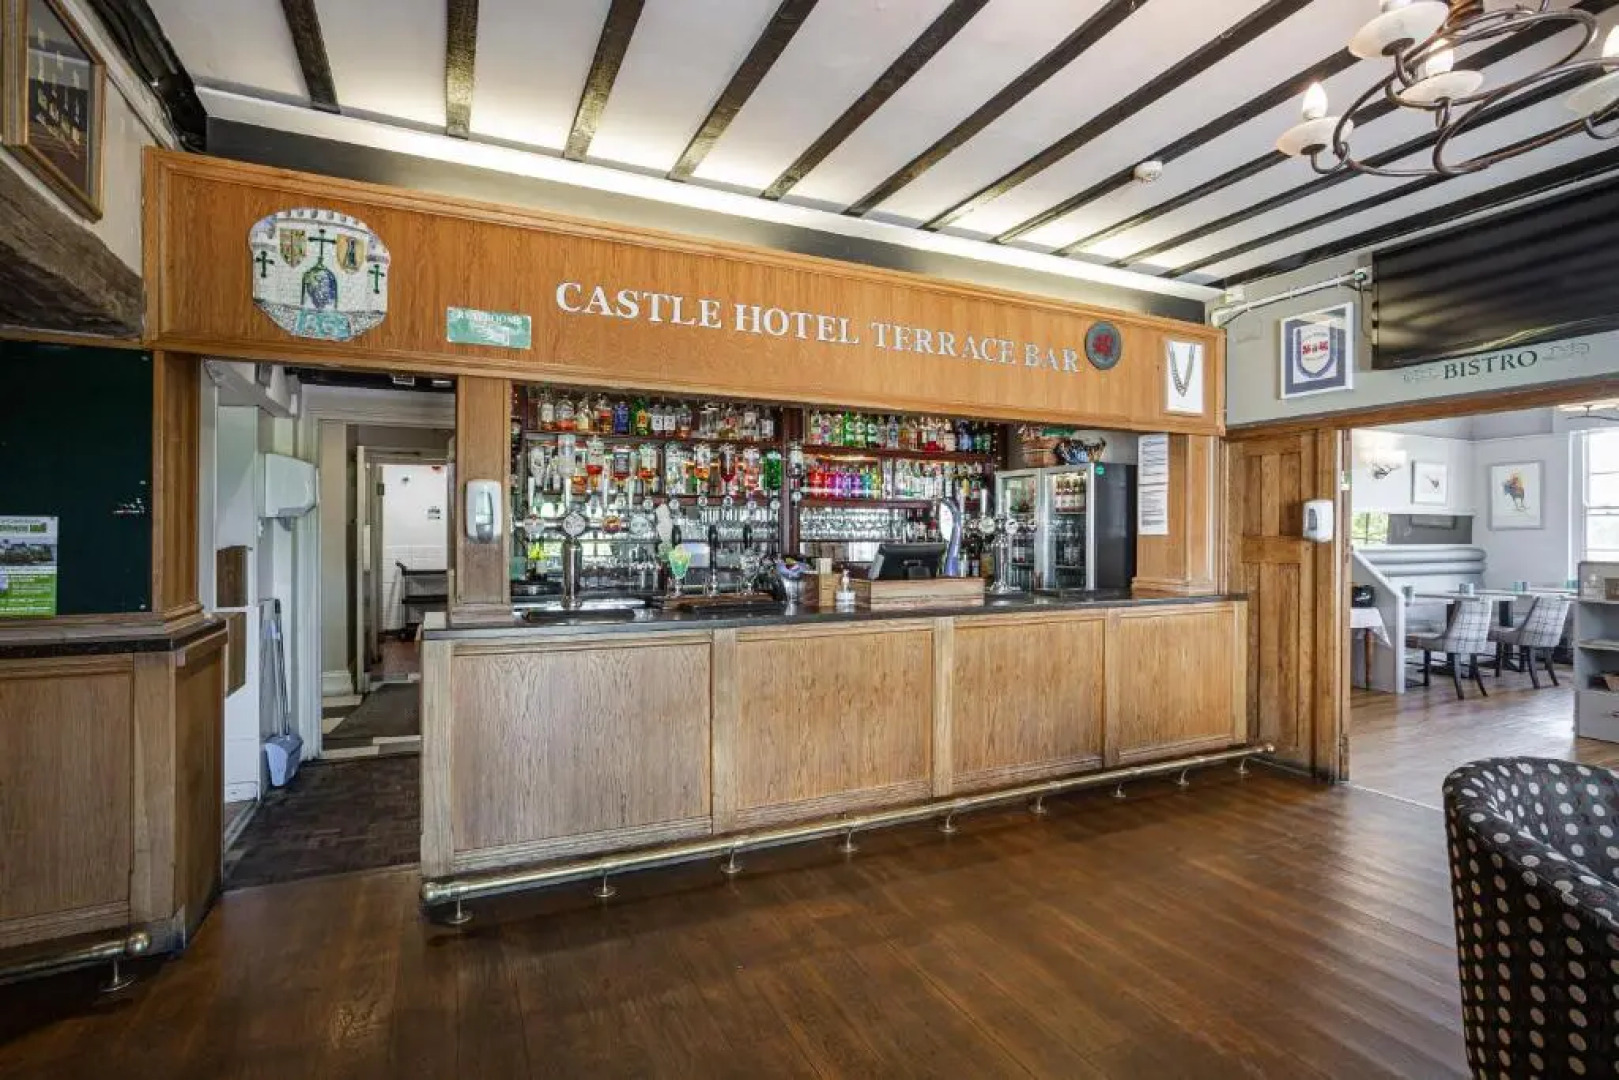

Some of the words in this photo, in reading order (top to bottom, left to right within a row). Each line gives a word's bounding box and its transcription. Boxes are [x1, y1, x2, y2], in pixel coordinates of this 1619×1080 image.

[555, 281, 723, 329] CASTLE
[734, 303, 860, 344] HOTEL
[870, 321, 1016, 365] TERRACE
[1023, 342, 1081, 373] BAR
[1443, 350, 1538, 379] BISTRO
